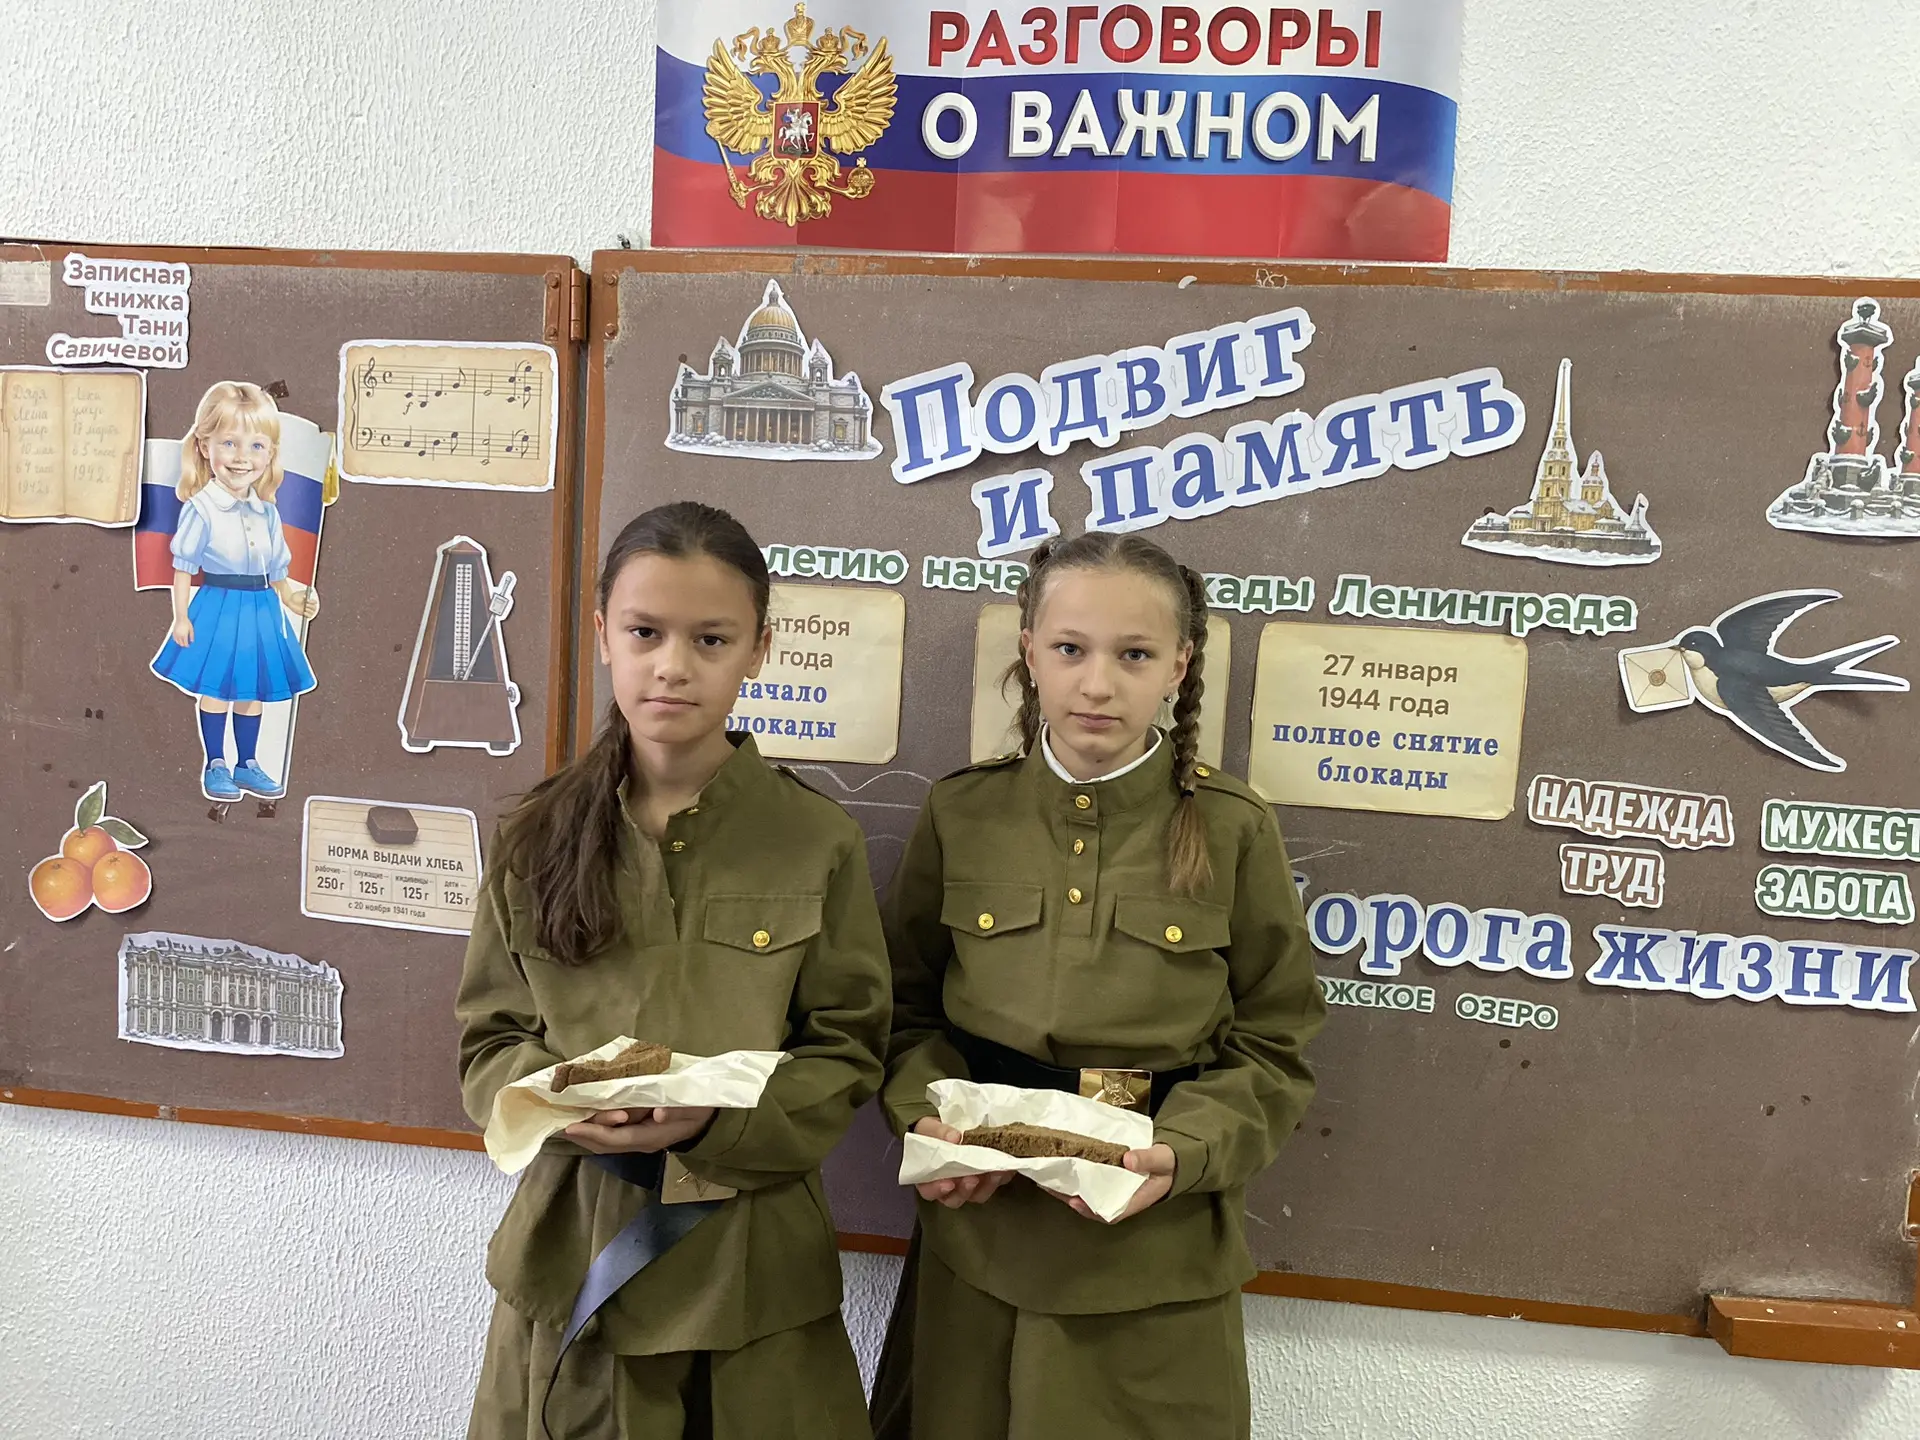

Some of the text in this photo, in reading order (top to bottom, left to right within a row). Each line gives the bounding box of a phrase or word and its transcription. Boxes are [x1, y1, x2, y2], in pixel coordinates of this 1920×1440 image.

[928, 2, 1382, 69] РАЗГОВОРЫ
[921, 89, 1380, 162] О ВАЖНОМ
[69, 259, 186, 286] Записная
[91, 290, 184, 311] книжка
[123, 314, 183, 337] Тани
[51, 339, 183, 363] Савичевой
[890, 319, 1301, 473] Подвиг
[980, 379, 1516, 549] и память
[767, 546, 1632, 633] летию нача кады Ленинграда
[766, 614, 850, 640] нтября
[779, 650, 833, 671] года
[1322, 653, 1458, 687] 27 января
[737, 681, 828, 703] начало
[1318, 686, 1450, 718] 1944 года
[1272, 723, 1499, 757] полное снятие
[1317, 757, 1449, 791] блокады
[1536, 781, 1725, 842] НАДЕЖДА
[1769, 807, 1920, 854] МУЖЕСТ
[328, 845, 464, 872] НОРМА ВЫДАЧИ ХЛЕБА
[317, 876, 338, 890] 250
[359, 881, 378, 894] 125
[1566, 850, 1656, 901] ТРУД
[354, 901, 364, 910] 20
[365, 904, 391, 914] ноября
[393, 906, 409, 915] 1941
[410, 909, 426, 918] года
[403, 886, 422, 900] 125
[444, 891, 463, 905] 125
[1763, 871, 1906, 916] ЗАБОТА
[1313, 896, 1913, 1004] орога жизни
[1317, 979, 1557, 1028] ЖСКОЕ ОЗЕРО
